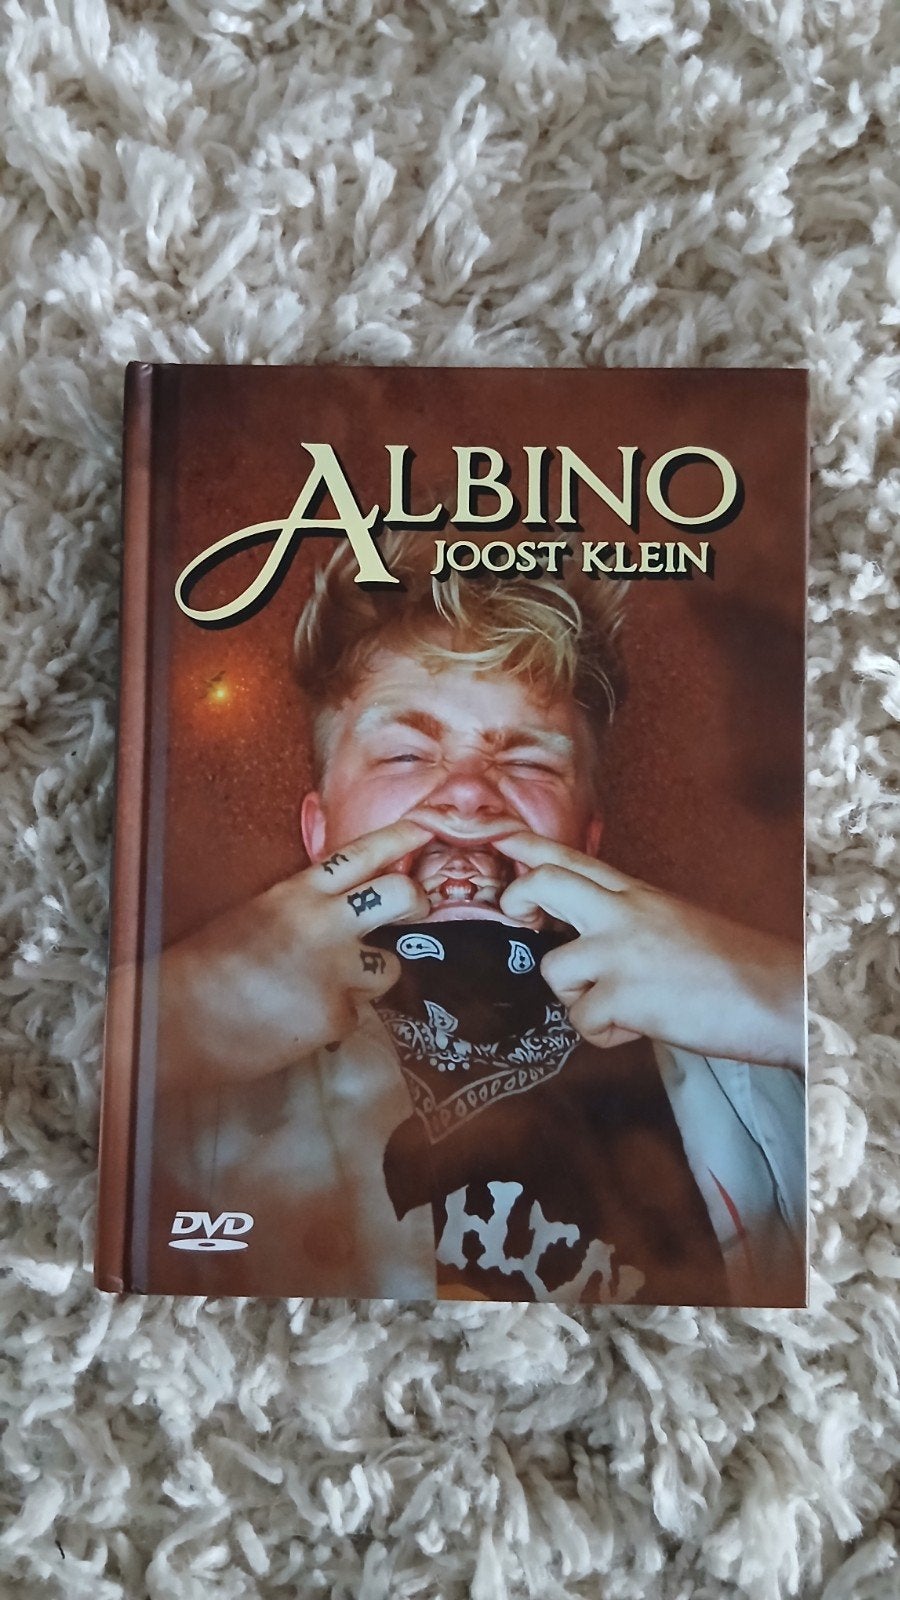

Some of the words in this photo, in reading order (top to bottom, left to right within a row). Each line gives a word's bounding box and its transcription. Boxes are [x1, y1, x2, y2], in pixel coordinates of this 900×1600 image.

[174, 442, 737, 621] ALBINO
[430, 540, 567, 575] JOOST
[581, 541, 710, 573] KLEIN
[171, 1211, 254, 1238] DVD
